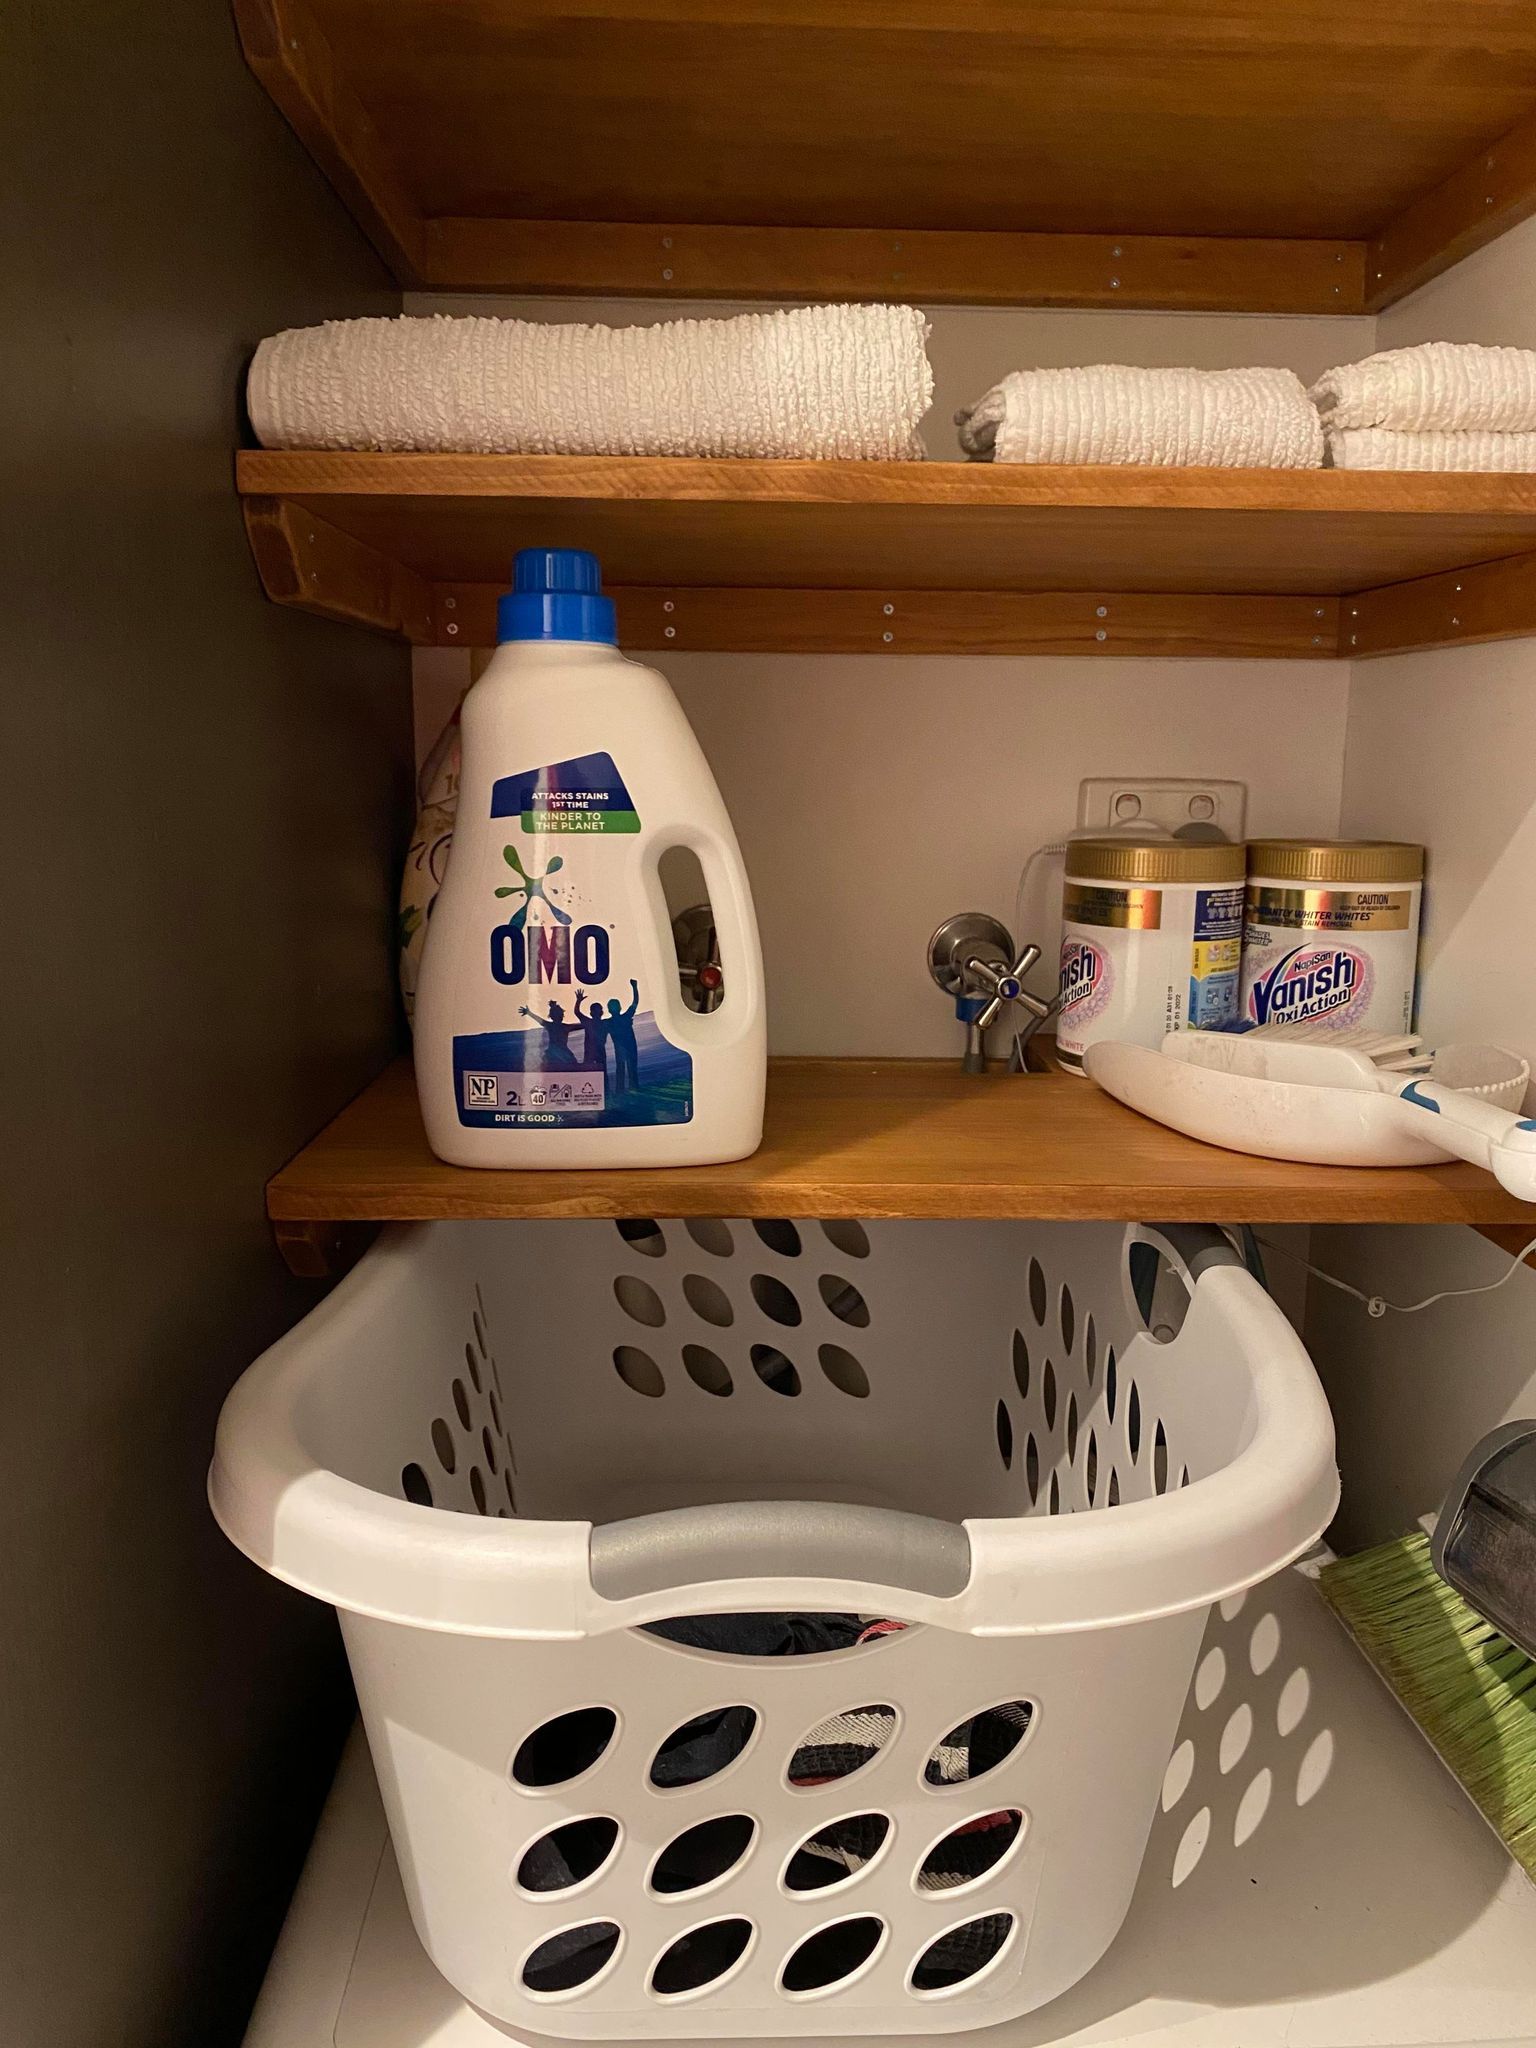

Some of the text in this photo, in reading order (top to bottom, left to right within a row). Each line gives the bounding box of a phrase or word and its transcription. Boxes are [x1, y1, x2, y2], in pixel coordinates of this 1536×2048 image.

[531, 792, 609, 800] ATTACKS STAINS
[540, 812, 601, 820] KINDER TO
[536, 822, 605, 830] THE PLANET
[1357, 894, 1389, 905] CAUTION
[1294, 909, 1332, 920] WHITER
[490, 924, 610, 986] OMO
[1060, 945, 1093, 993] nish
[1253, 944, 1352, 1024] Vanish
[1276, 989, 1348, 1024] Oxi Action
[471, 1078, 495, 1096] NP
[532, 1095, 544, 1104] 40
[495, 1114, 555, 1122] DIRT IS GOOD
